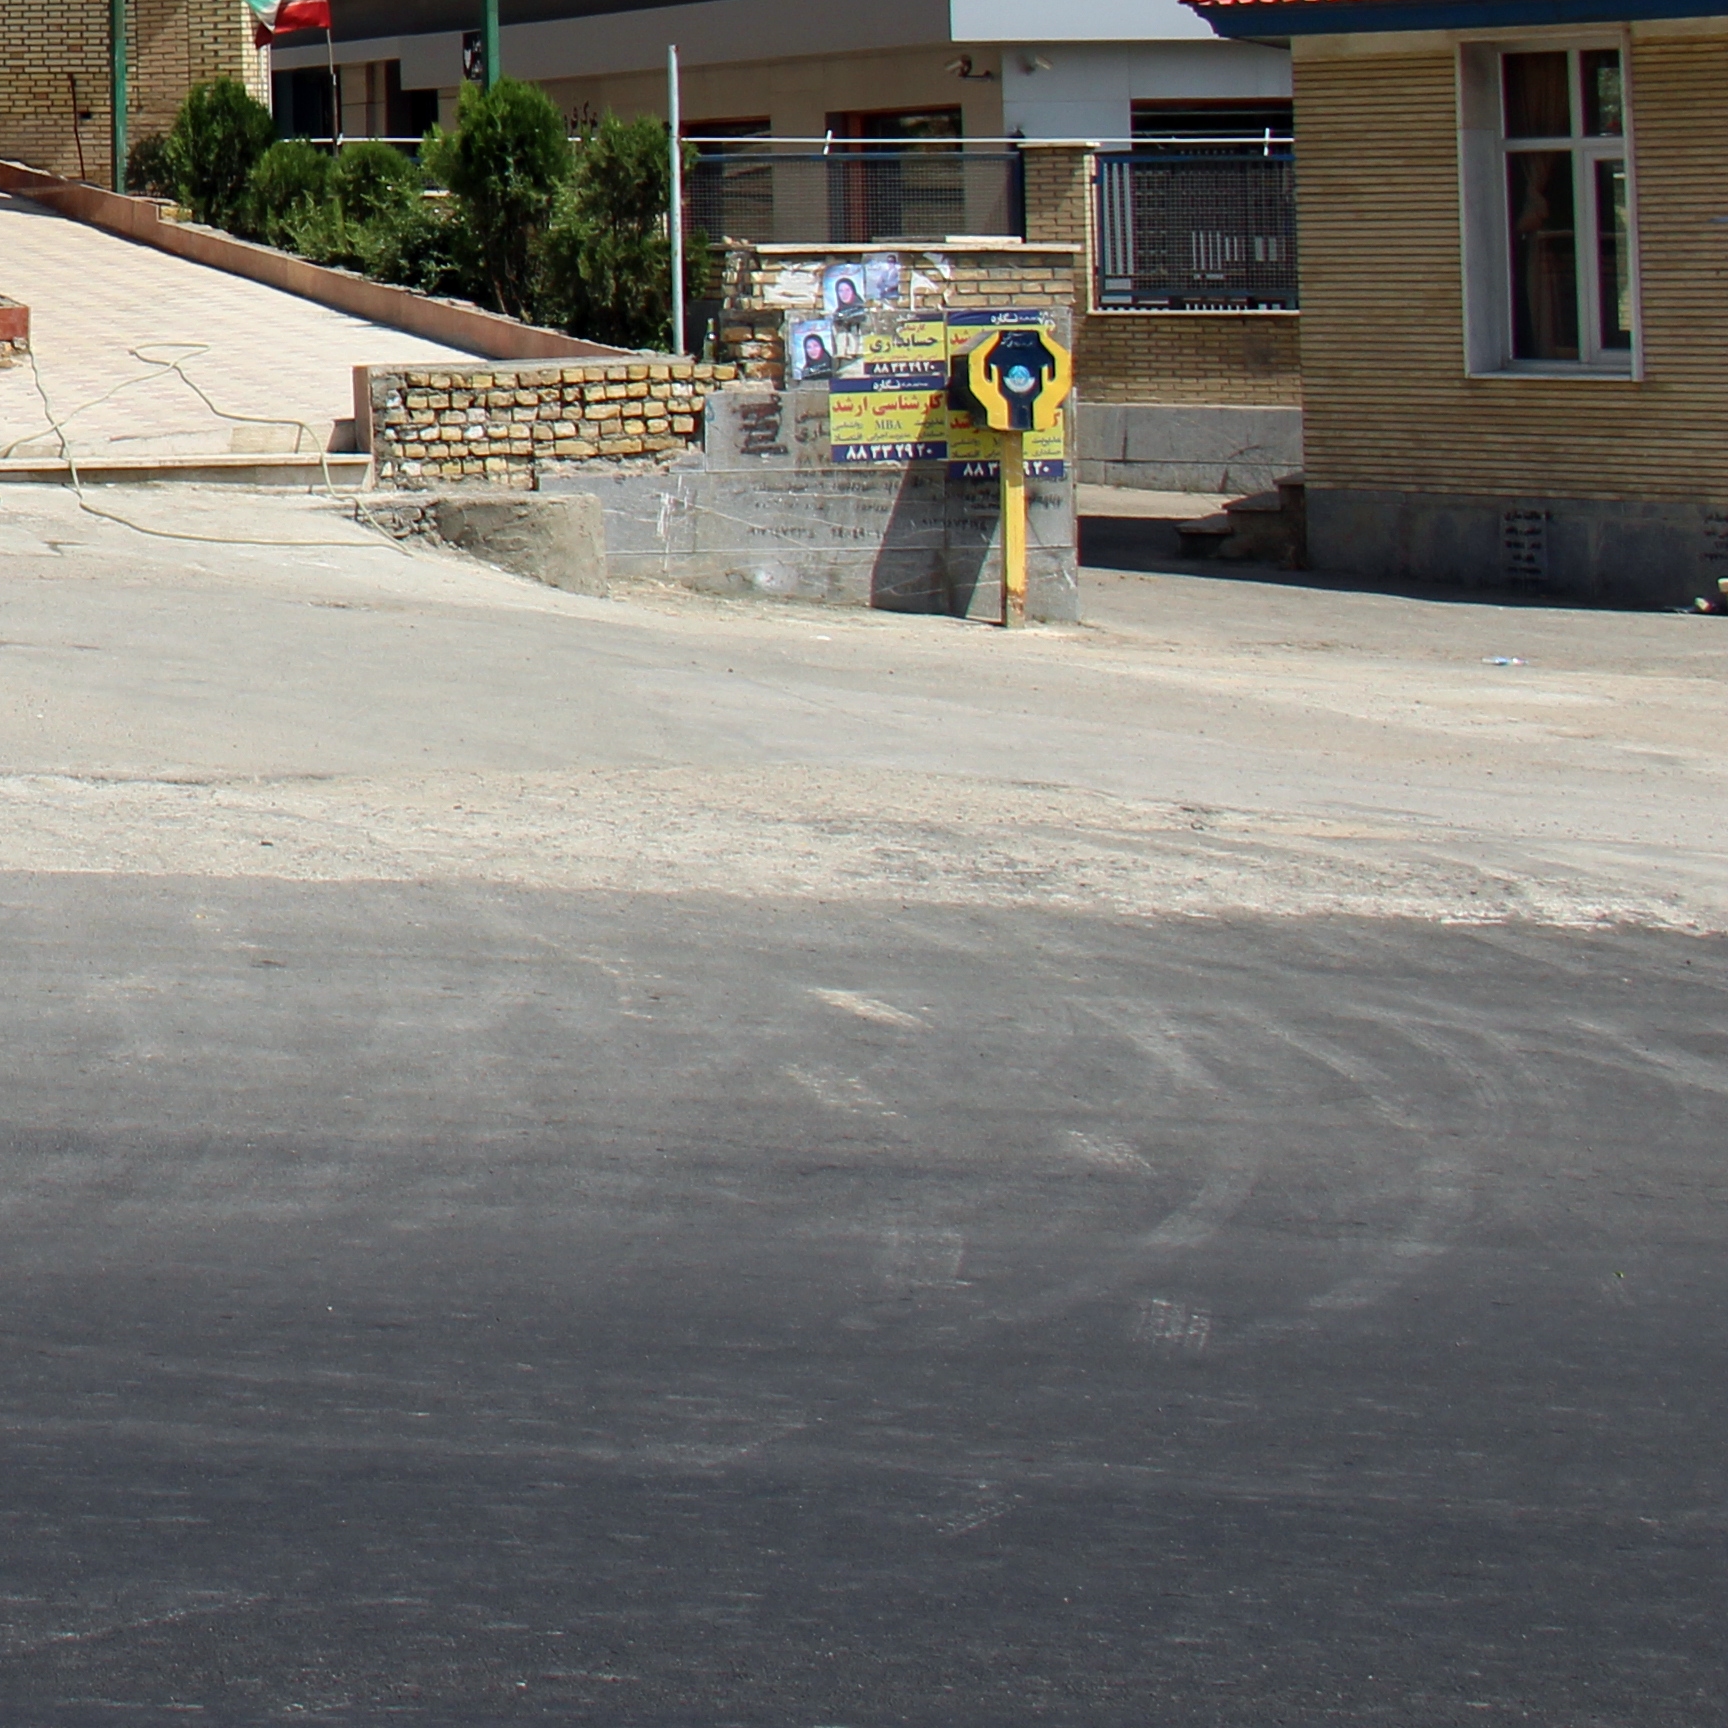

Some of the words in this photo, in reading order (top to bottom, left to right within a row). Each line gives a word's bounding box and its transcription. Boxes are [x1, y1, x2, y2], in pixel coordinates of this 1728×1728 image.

[831, 396, 868, 417] ارشد
[872, 393, 942, 416] کارشناسی
[874, 420, 902, 430] MBA
[846, 445, 868, 460] ۸۸
[870, 444, 892, 459] ۳۳
[895, 443, 914, 458] ۲۹
[916, 443, 933, 457] ۲۰
[963, 463, 984, 476] ۸۸
[988, 463, 1000, 476] ۳
[1033, 461, 1050, 475] ۲۰
